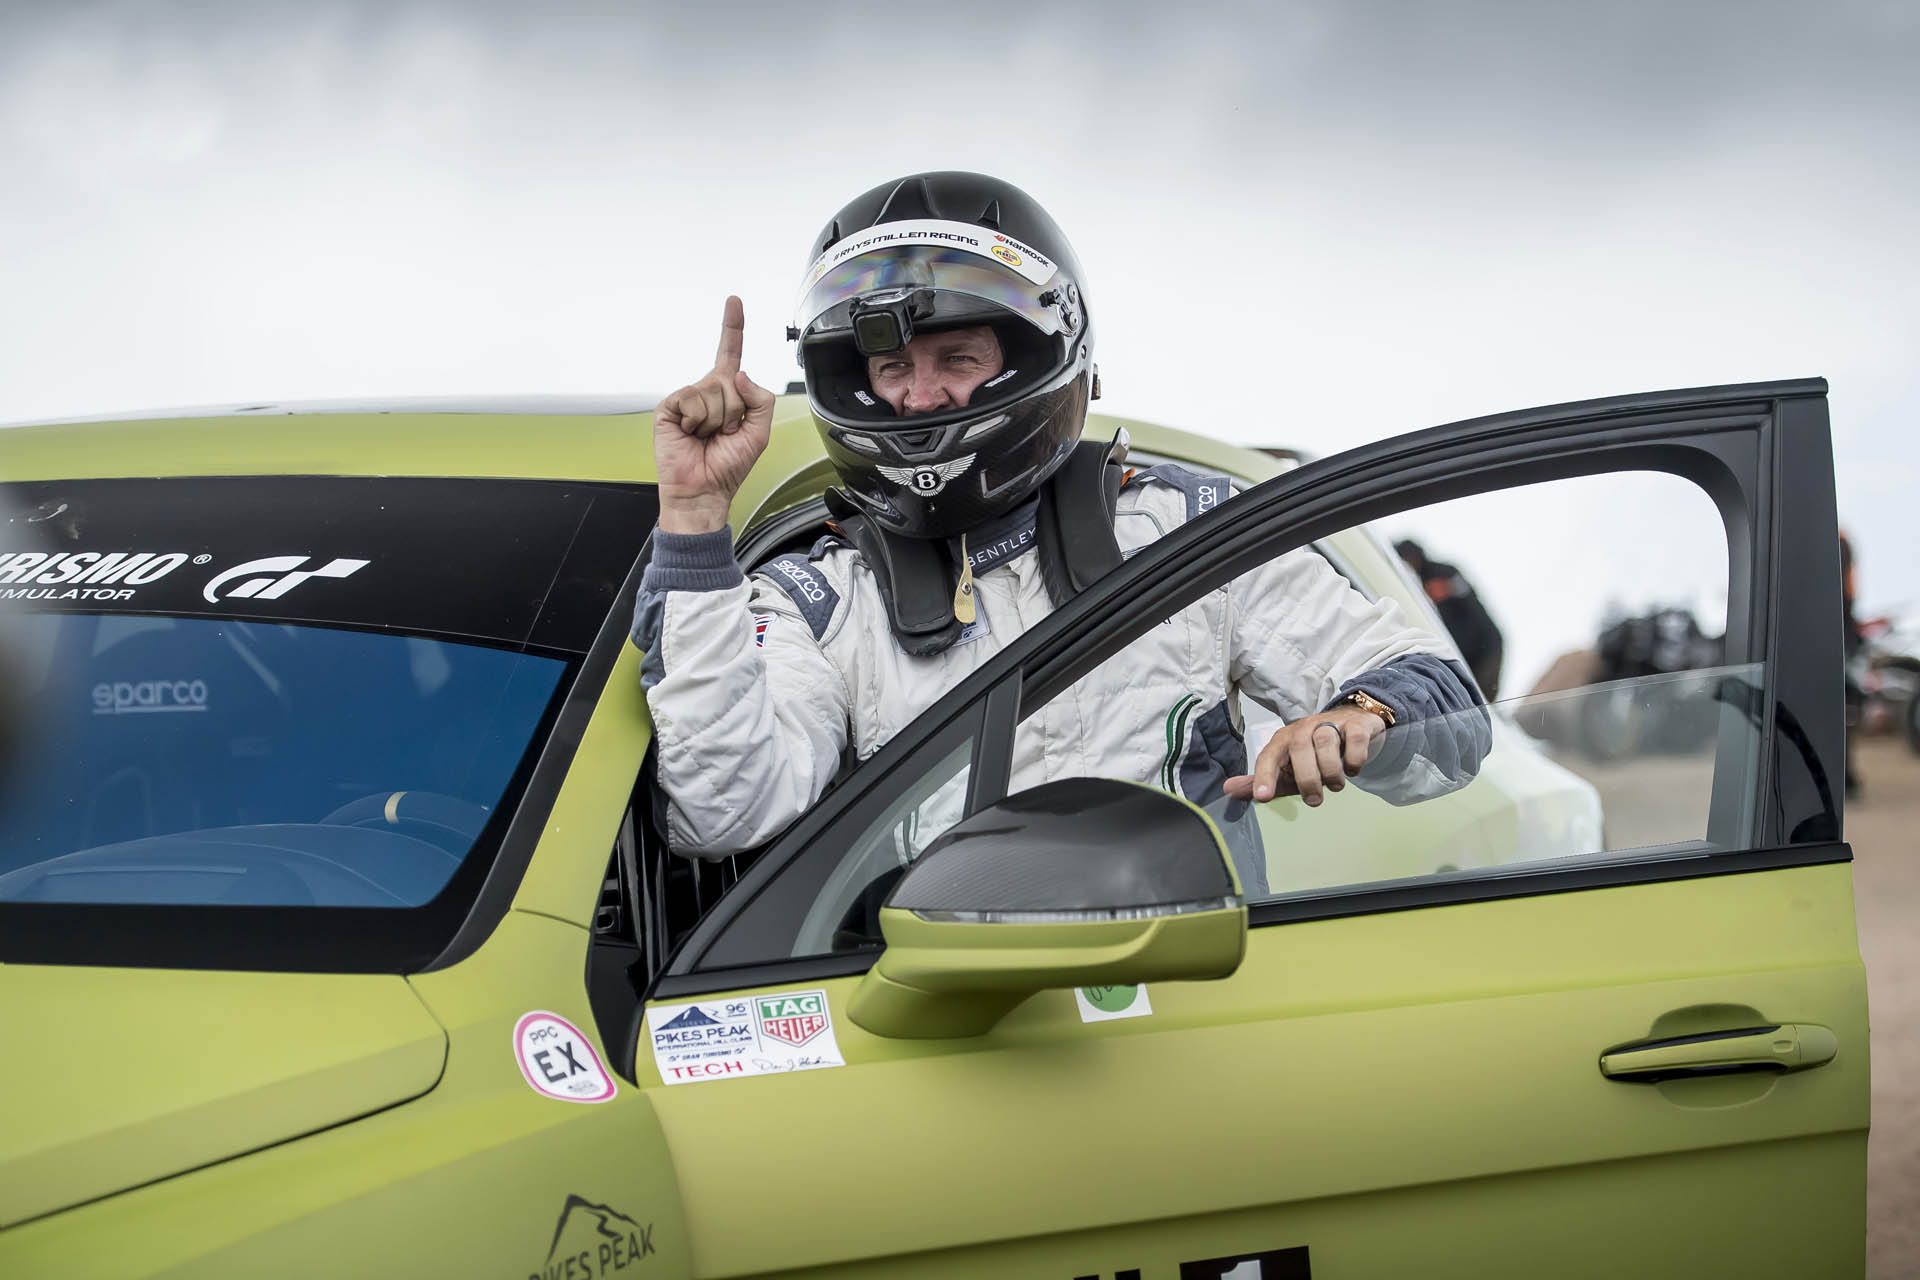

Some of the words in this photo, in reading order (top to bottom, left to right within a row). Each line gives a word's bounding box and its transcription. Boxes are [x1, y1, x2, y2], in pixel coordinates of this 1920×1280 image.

[872, 231, 928, 244] MILLEN
[929, 231, 979, 247] RACING
[967, 527, 1037, 568] BENTLEY
[774, 559, 826, 602] sparco
[92, 678, 208, 713] sparco
[763, 998, 819, 1017] TAG
[529, 1026, 558, 1043] PPC
[655, 1030, 703, 1044] PIKES
[707, 1024, 751, 1039] PEAK
[764, 1015, 825, 1044] HEUER
[657, 1041, 712, 1051] INTERNATIONAL
[533, 1041, 587, 1083] EX
[668, 1060, 743, 1079] TECH
[598, 1223, 656, 1277] PEAK
